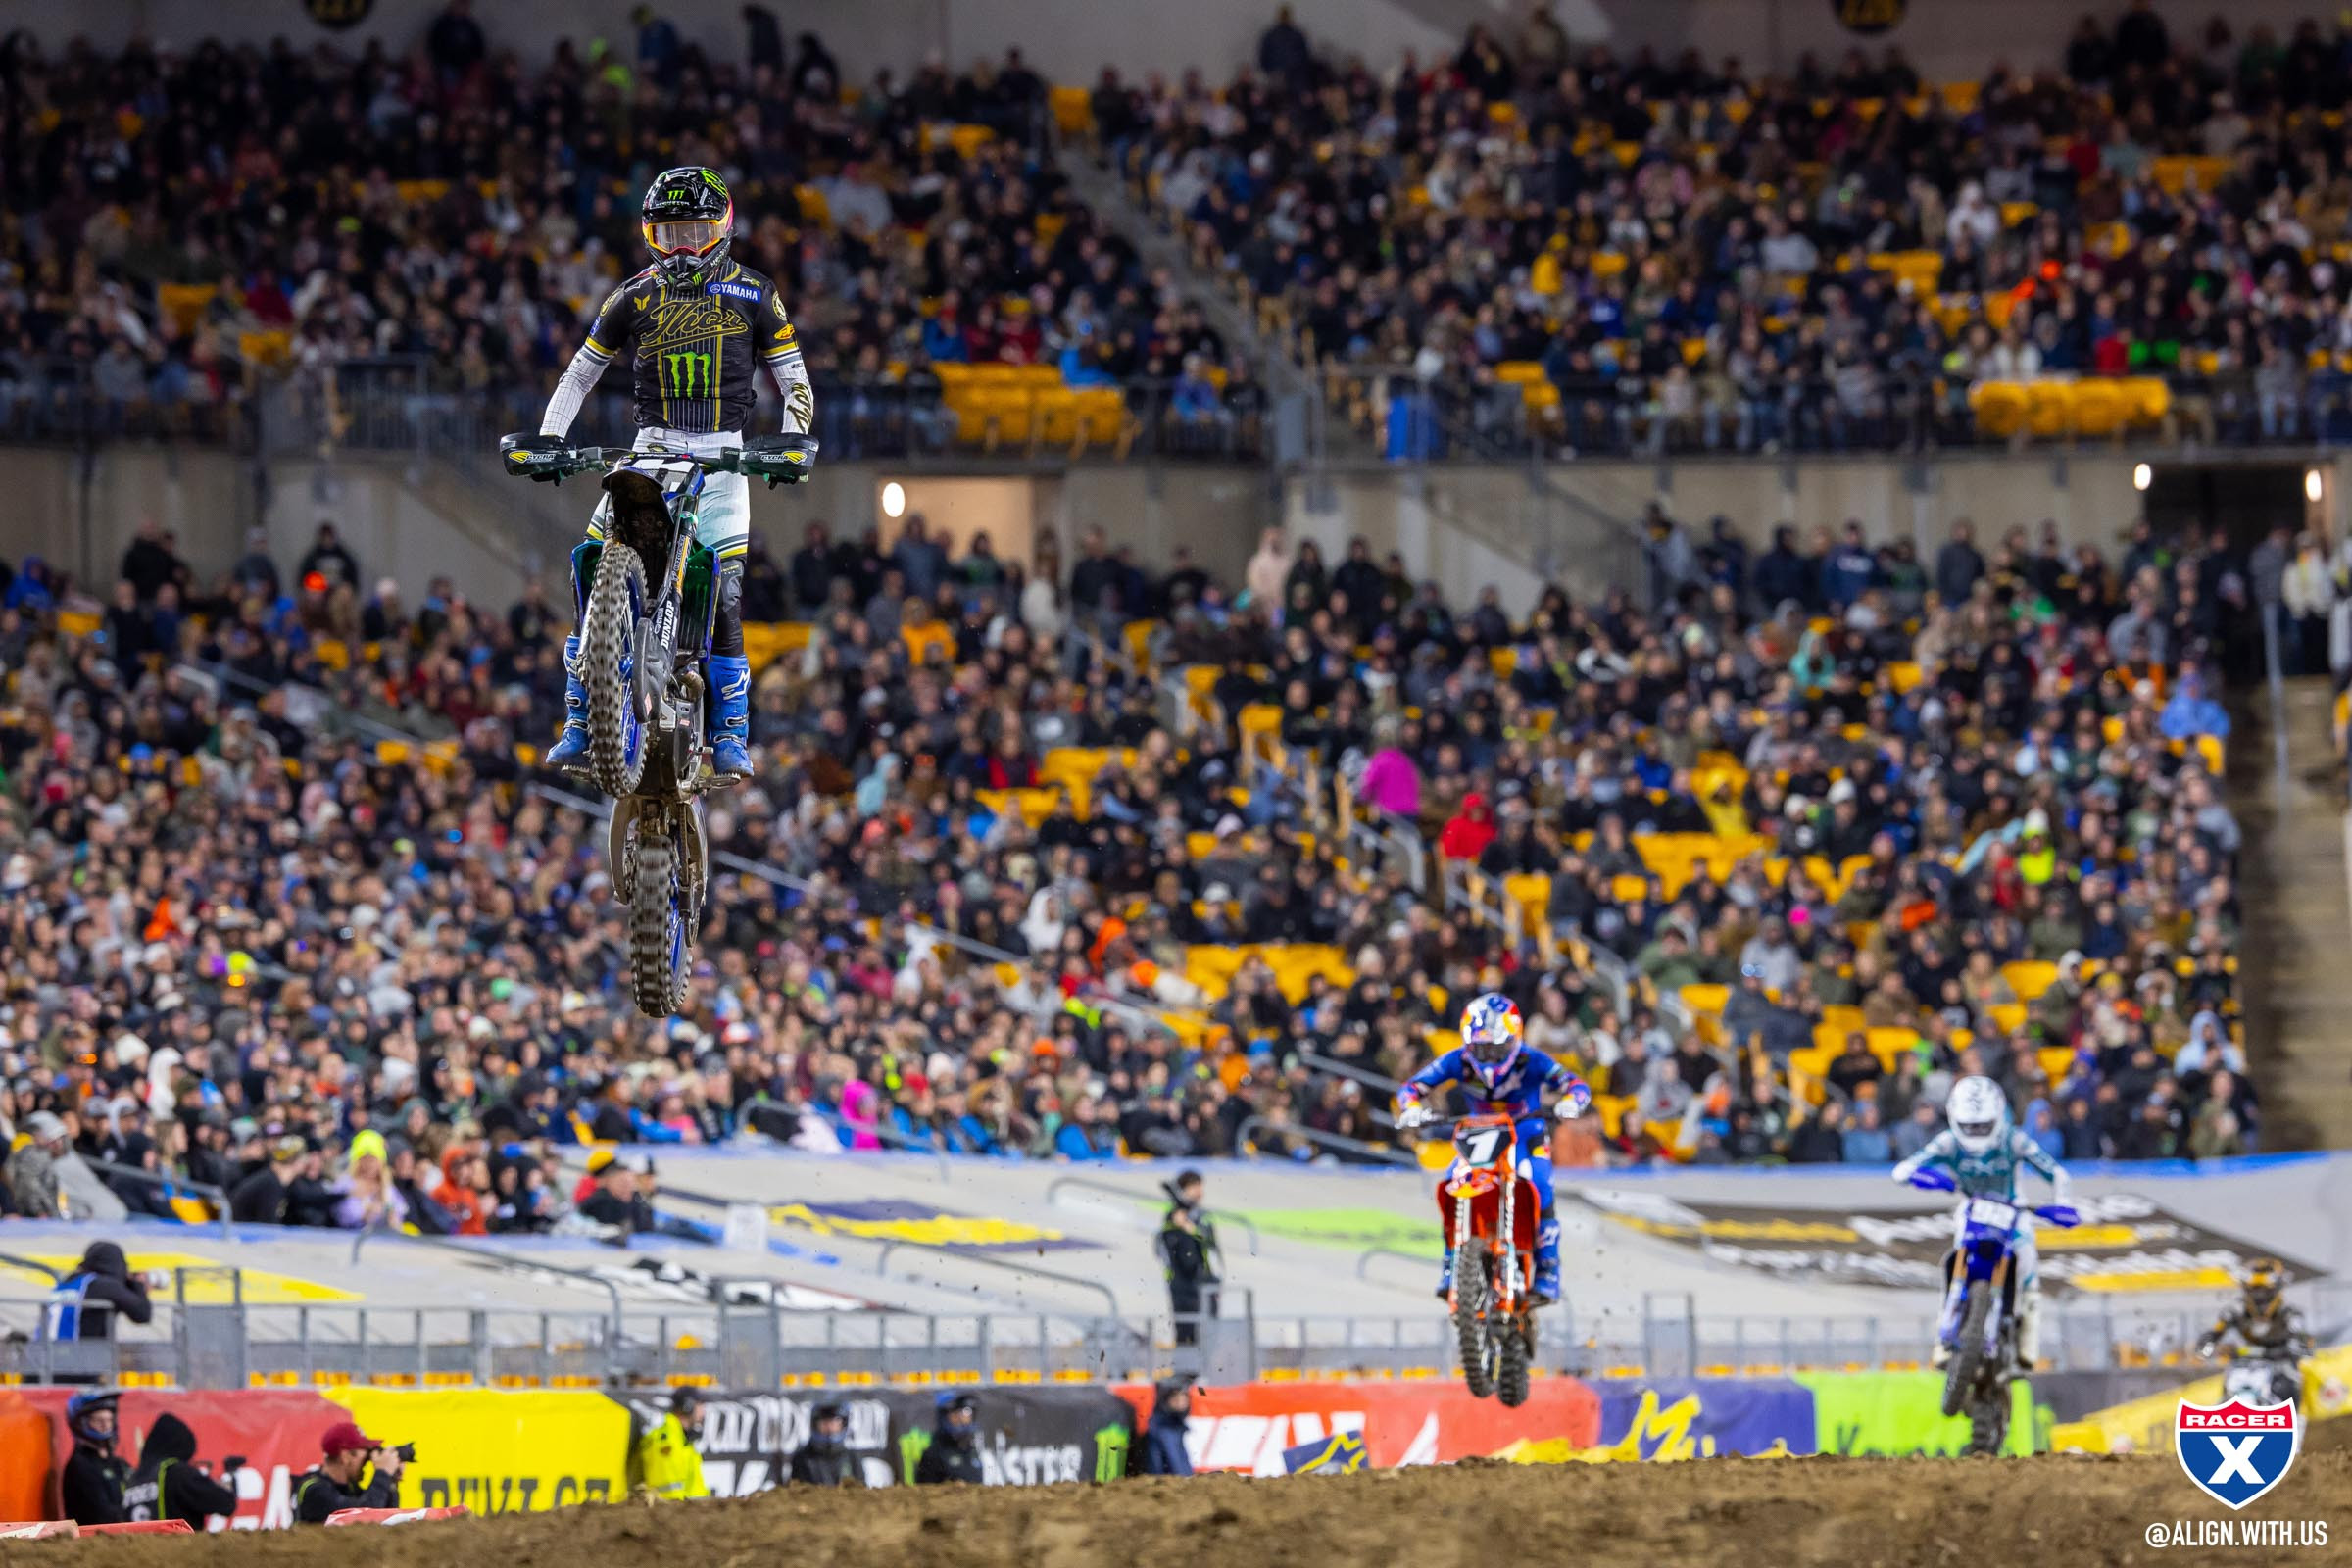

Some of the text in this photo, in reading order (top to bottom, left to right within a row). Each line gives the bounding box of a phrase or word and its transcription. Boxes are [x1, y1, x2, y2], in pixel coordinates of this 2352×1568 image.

[721, 283, 759, 301] YAMAHA
[639, 296, 749, 348] Thor
[661, 600, 675, 650] DUNLOP
[1465, 1129, 1500, 1165] 1
